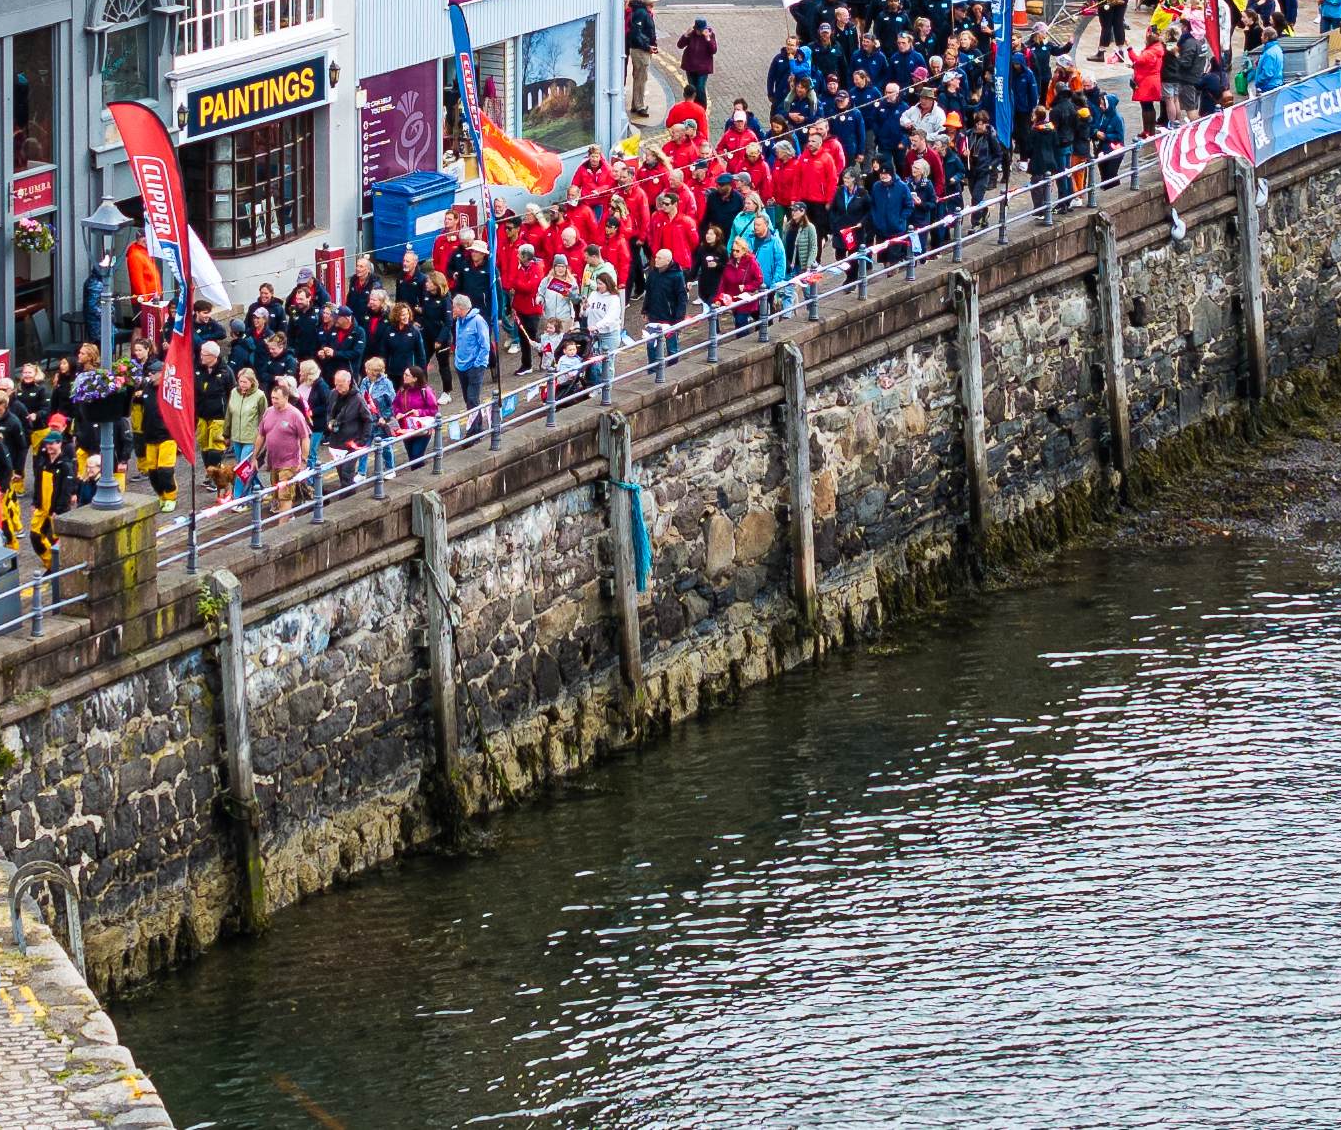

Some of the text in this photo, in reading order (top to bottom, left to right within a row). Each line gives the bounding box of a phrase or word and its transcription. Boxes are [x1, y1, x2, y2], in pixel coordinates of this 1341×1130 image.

[200, 67, 315, 128] PAINTINGS
[1283, 100, 1322, 128] FREE
[142, 164, 172, 240] CLIPPER
